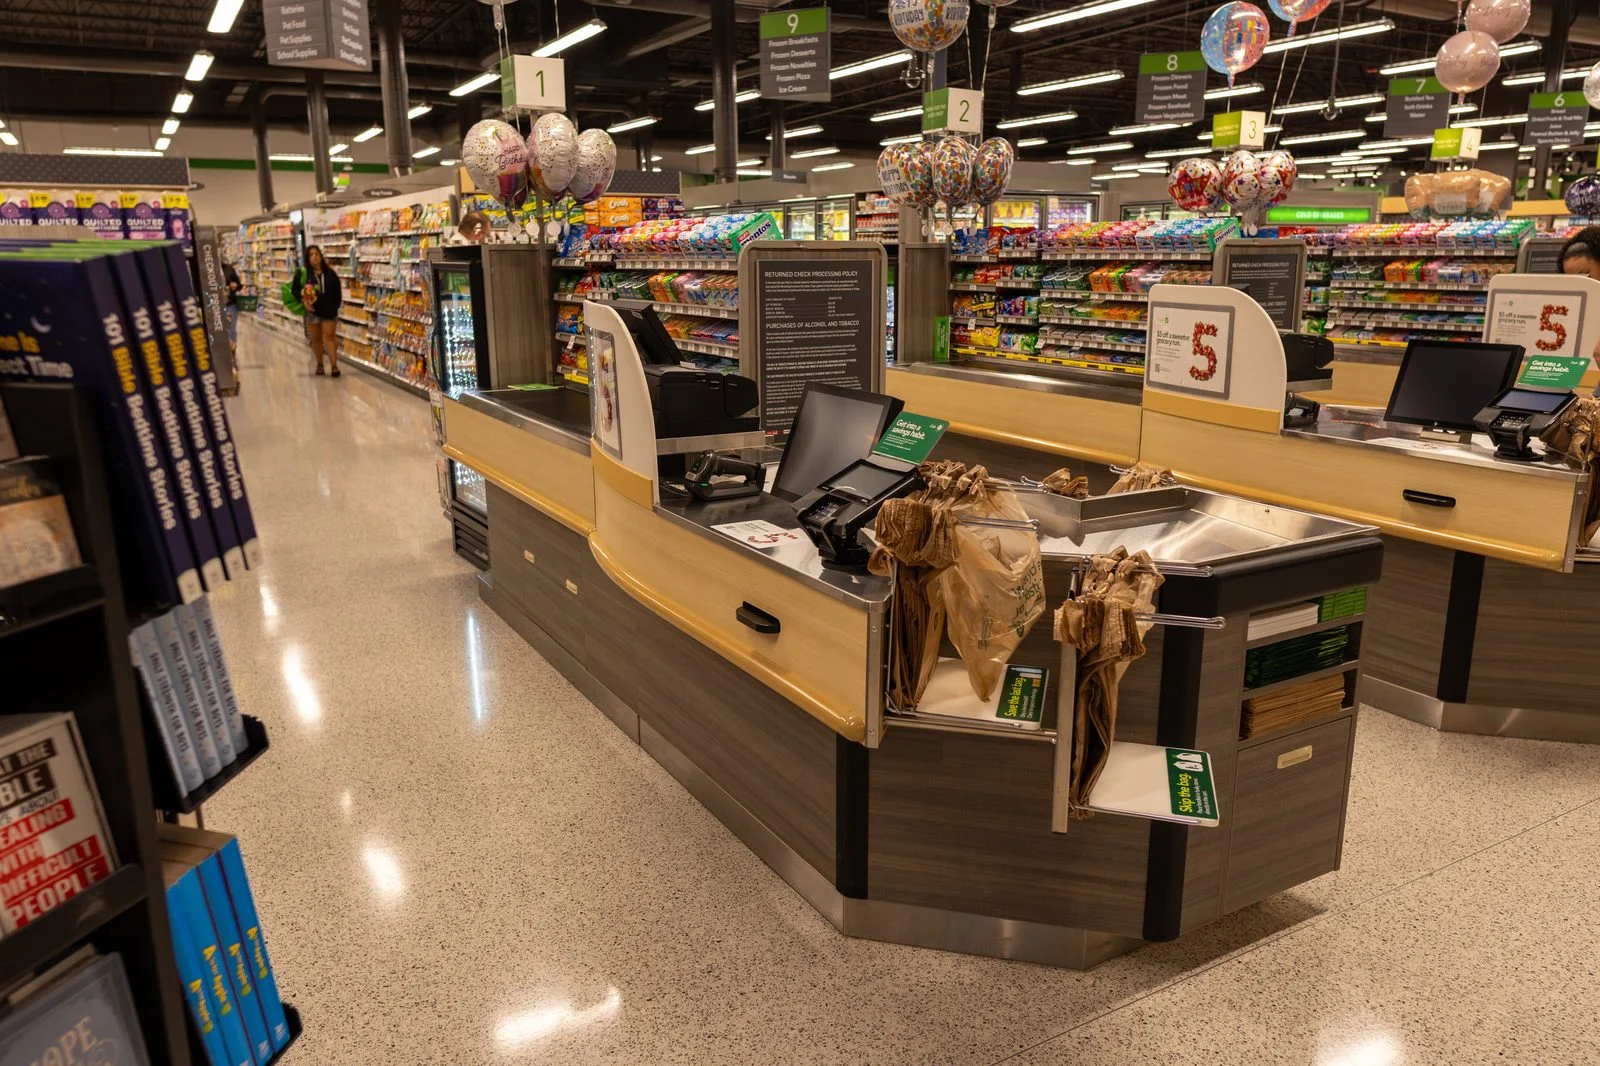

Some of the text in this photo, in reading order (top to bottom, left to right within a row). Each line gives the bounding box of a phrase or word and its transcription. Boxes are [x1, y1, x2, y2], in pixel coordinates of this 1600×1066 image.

[787, 14, 798, 33] 9
[1167, 54, 1178, 71] 8
[535, 70, 545, 97] 1
[1416, 79, 1426, 93] 7
[1554, 93, 1565, 107] 6
[960, 100, 969, 122] 2
[1249, 120, 1257, 139] 3
[1466, 136, 1473, 152] 4
[38, 218, 78, 226] QUILTED
[83, 218, 122, 227] QUILTED
[127, 218, 164, 227] QUILTED
[203, 244, 223, 332] CHECKOUT PROMISE
[1536, 304, 1569, 352] 5
[1189, 320, 1218, 381] 5
[157, 301, 224, 509] 101 Bible Bedtime Stories
[182, 296, 243, 500] 101 Bible Bedtime Stories
[103, 313, 177, 531] 101 Bible Bedtime Stories
[133, 307, 202, 520] 101 Bible Bedtime Stories
[891, 427, 926, 440] savings habit.
[896, 419, 908, 428] Get
[907, 421, 918, 430] into
[1007, 695, 1020, 705] the
[1004, 704, 1019, 717] Save
[20, 743, 52, 765] THE
[0, 768, 46, 804] BLE
[1176, 773, 1196, 813] Skip the bag.
[28, 1016, 98, 1066] OPE
